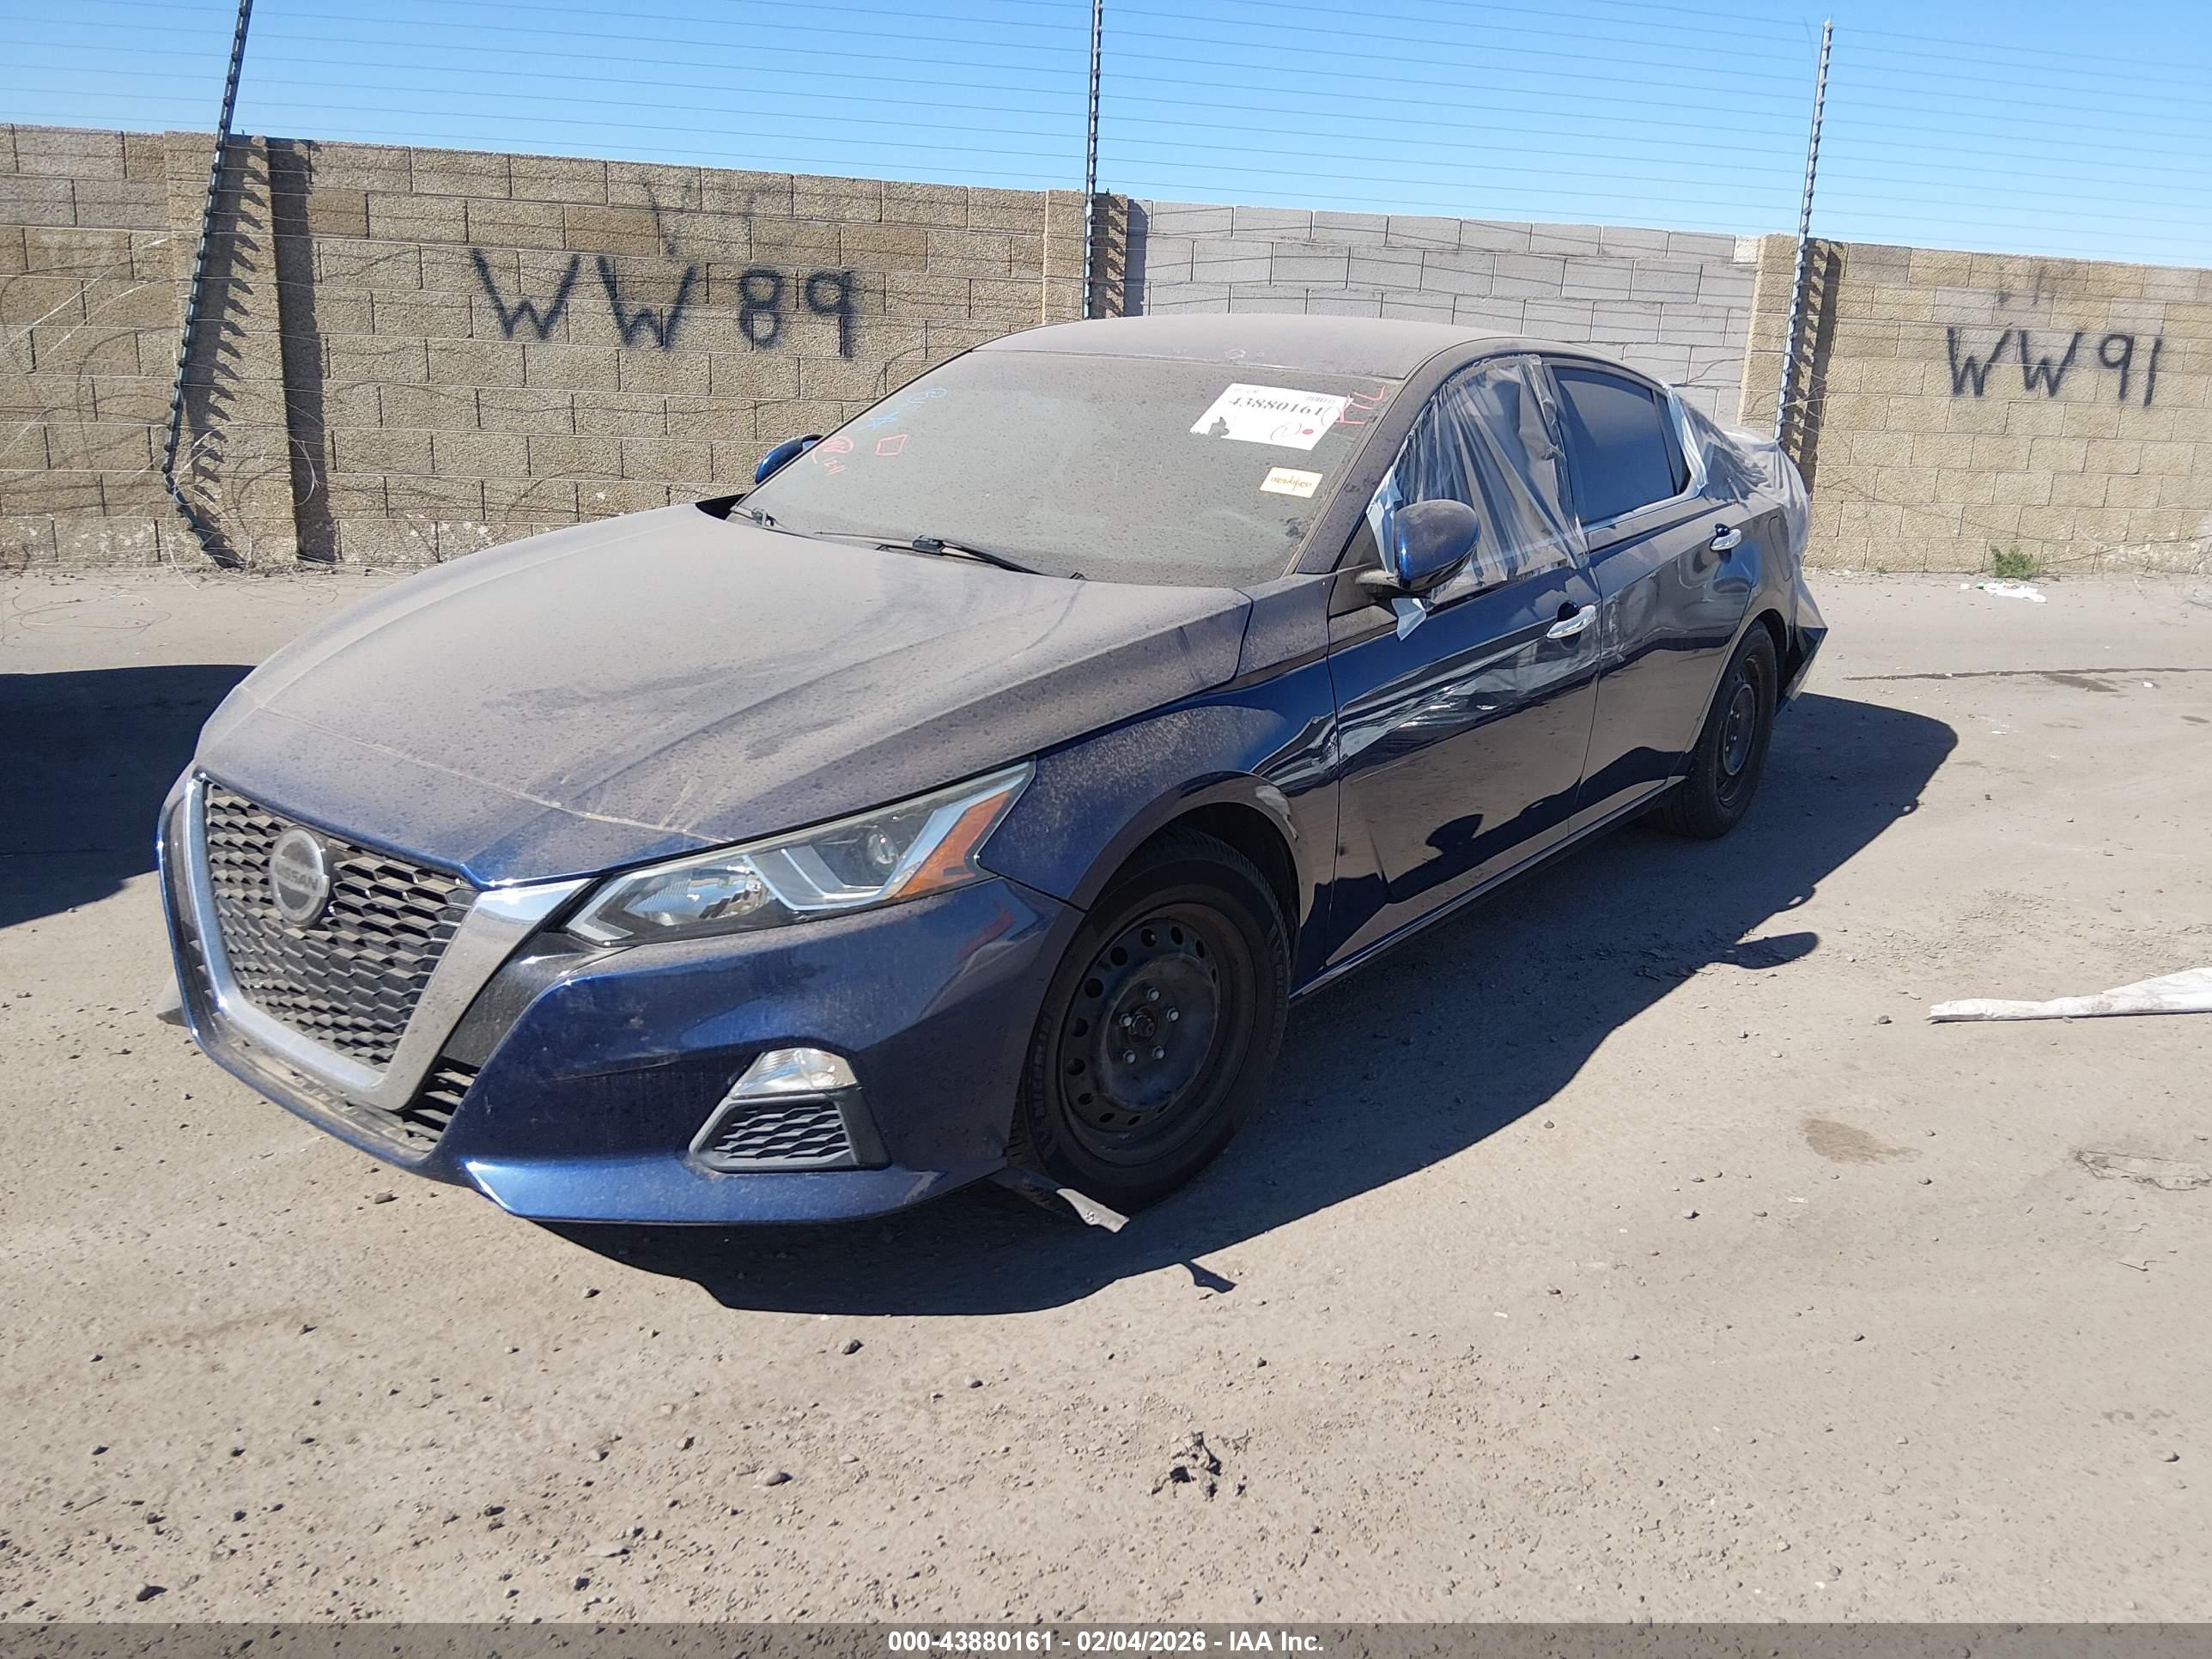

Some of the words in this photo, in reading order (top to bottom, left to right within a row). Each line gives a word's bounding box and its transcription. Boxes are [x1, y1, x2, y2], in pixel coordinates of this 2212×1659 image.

[470, 247, 697, 349] WW
[736, 268, 857, 358] 89
[1229, 396, 1324, 416] 43880161
